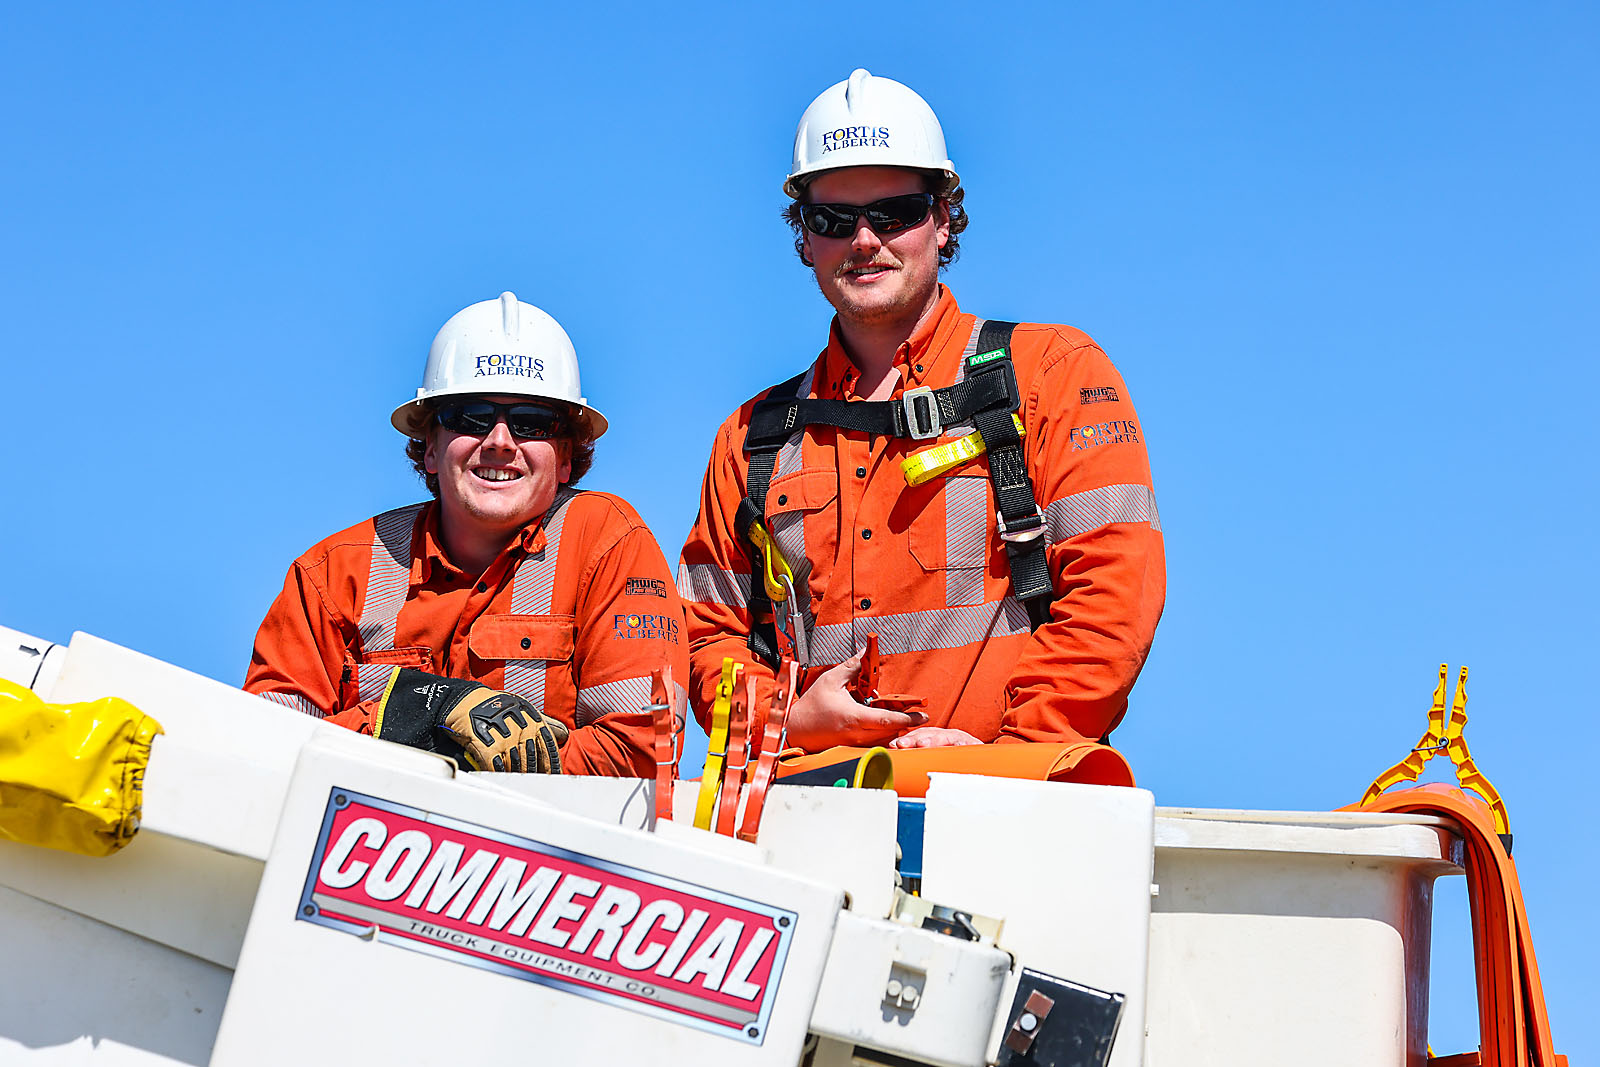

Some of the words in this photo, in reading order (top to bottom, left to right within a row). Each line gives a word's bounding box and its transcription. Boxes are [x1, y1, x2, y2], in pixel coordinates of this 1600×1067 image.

[822, 126, 889, 146] FORTIS
[822, 138, 890, 154] ALBERTA
[475, 354, 544, 371] FORTIS
[971, 350, 1003, 365] MSA
[474, 367, 544, 381] ALBERTA
[1069, 421, 1137, 442] FORTIS
[1072, 434, 1139, 452] ALBERTA
[631, 579, 657, 588] MWG
[613, 614, 679, 634] FORTIS
[613, 629, 679, 645] ALBERTA
[319, 817, 775, 1001] COMMERCIAL
[409, 921, 479, 948] TRUCK
[490, 944, 613, 984] EQUIPMENT
